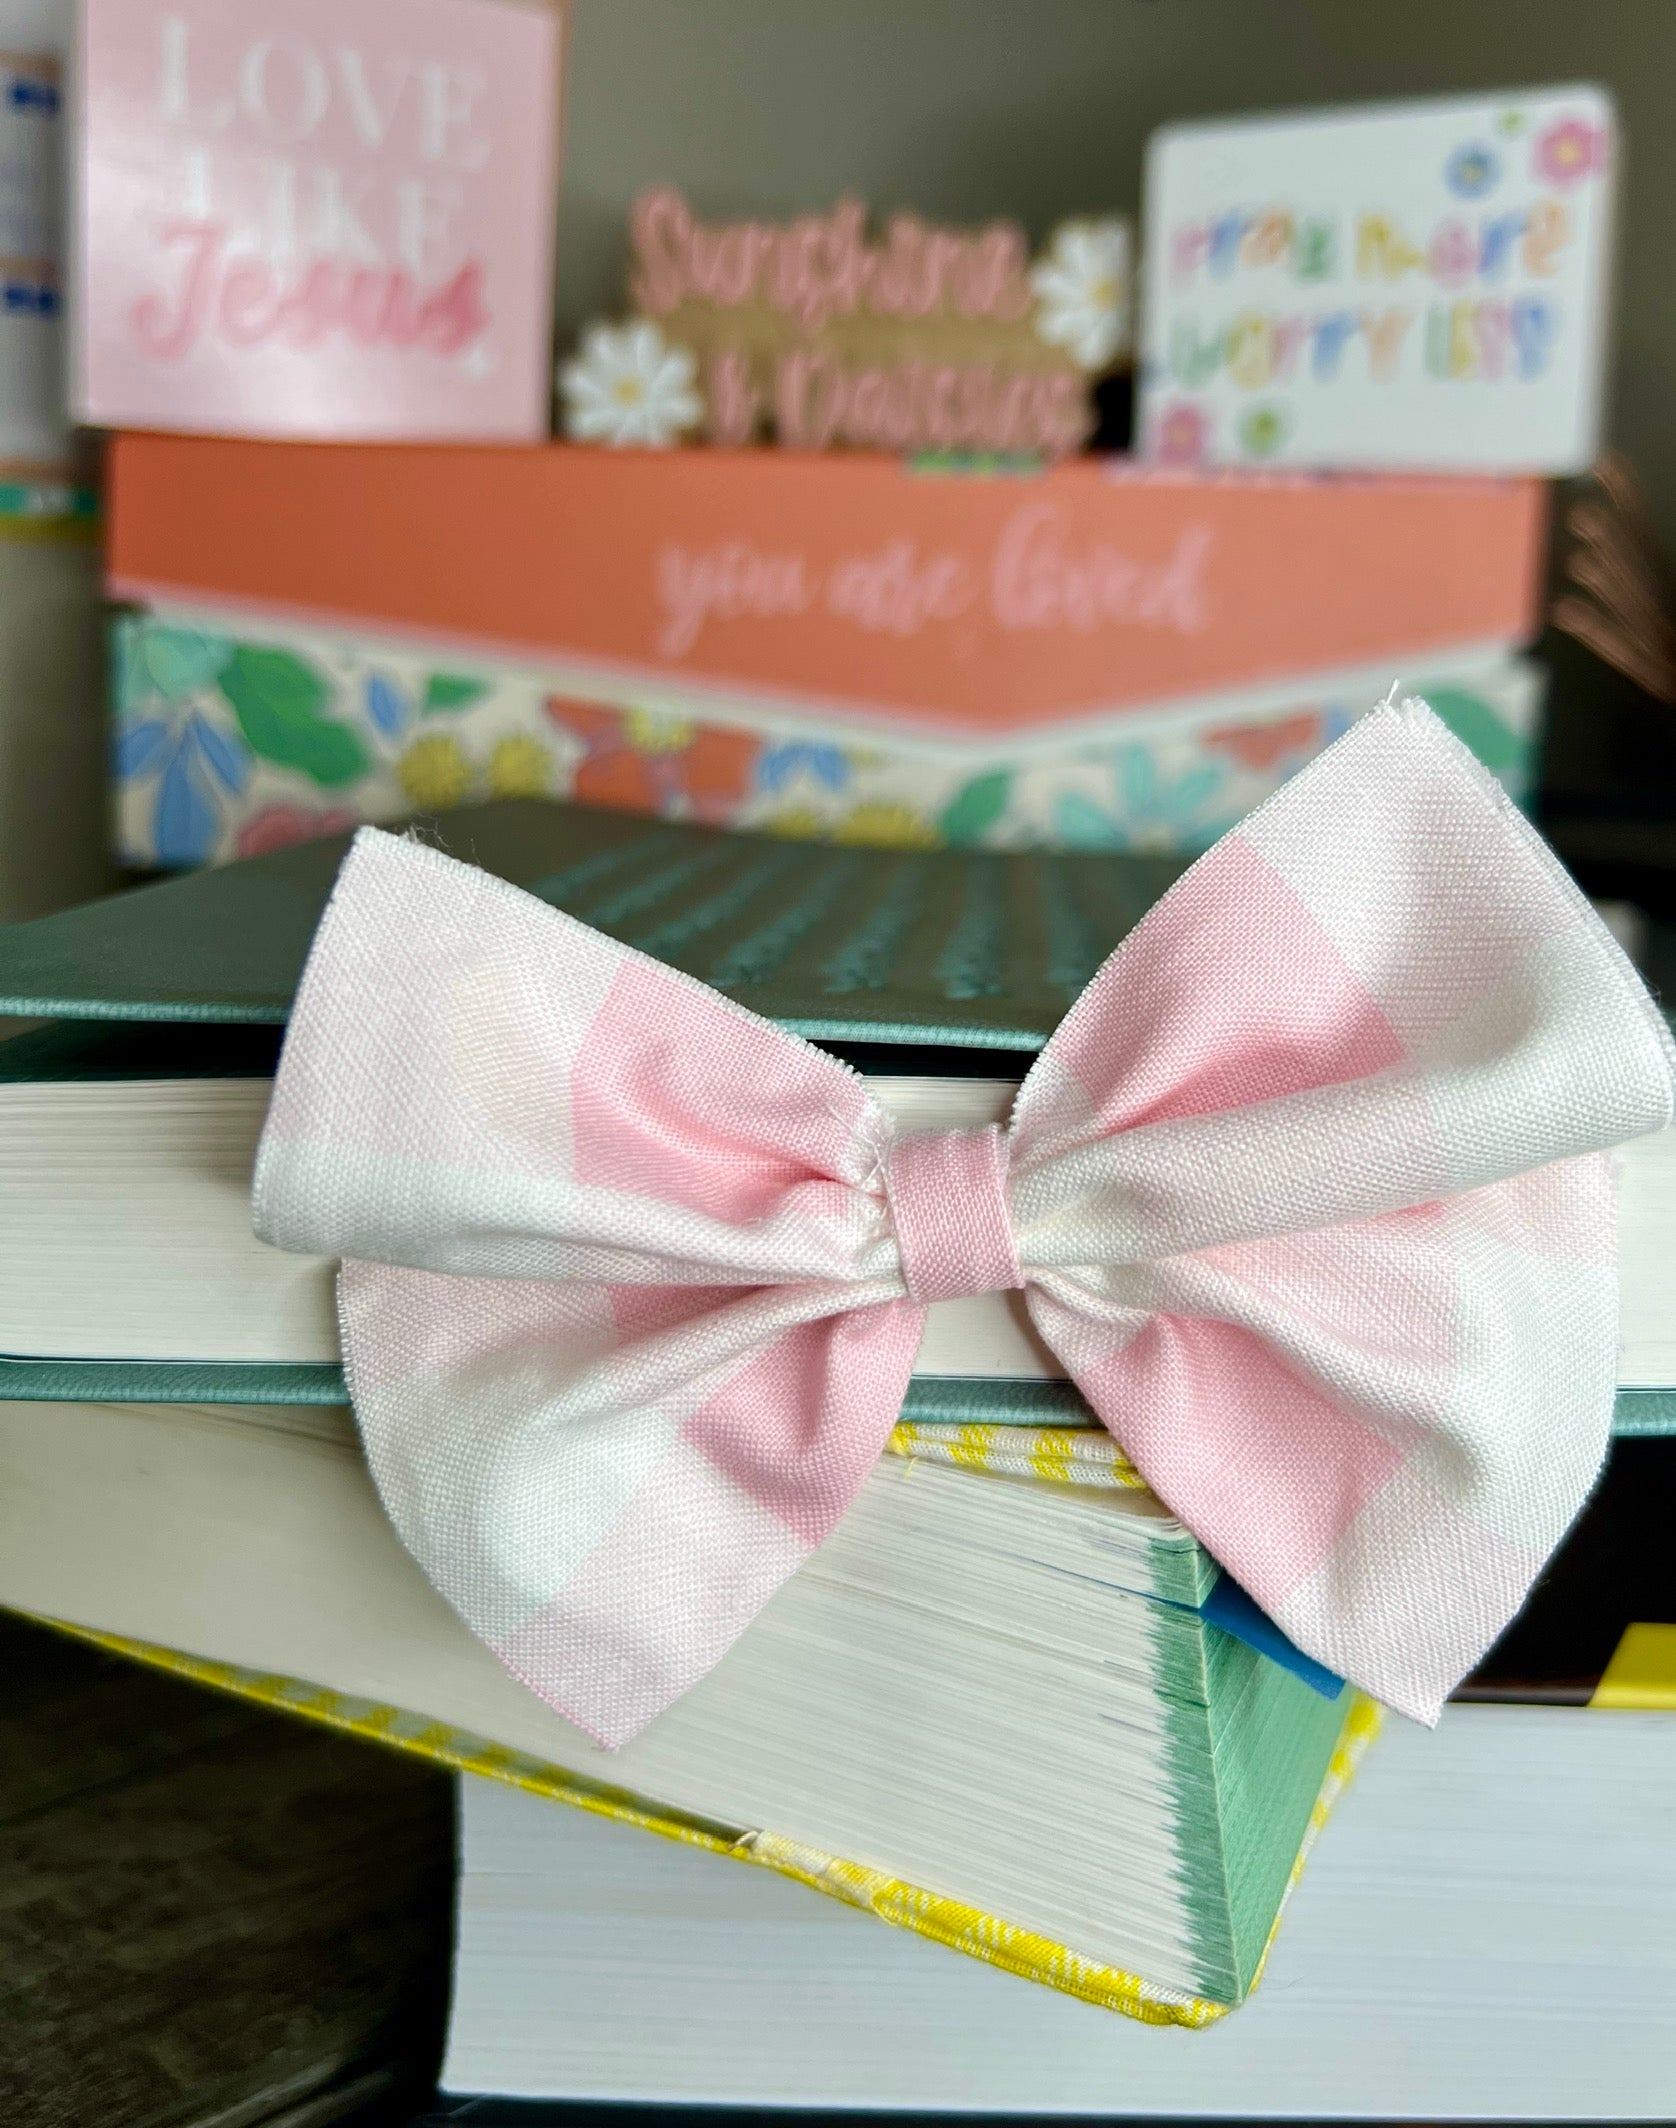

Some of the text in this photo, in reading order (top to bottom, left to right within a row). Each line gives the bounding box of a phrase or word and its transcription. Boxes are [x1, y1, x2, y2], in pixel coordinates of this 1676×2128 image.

[158, 18, 490, 171] LOVE
[178, 148, 466, 288] LIKE
[633, 187, 1032, 328] Sunshine
[1356, 200, 1570, 285] more
[1170, 306, 1413, 390] worry
[656, 502, 1214, 656] you are loved
